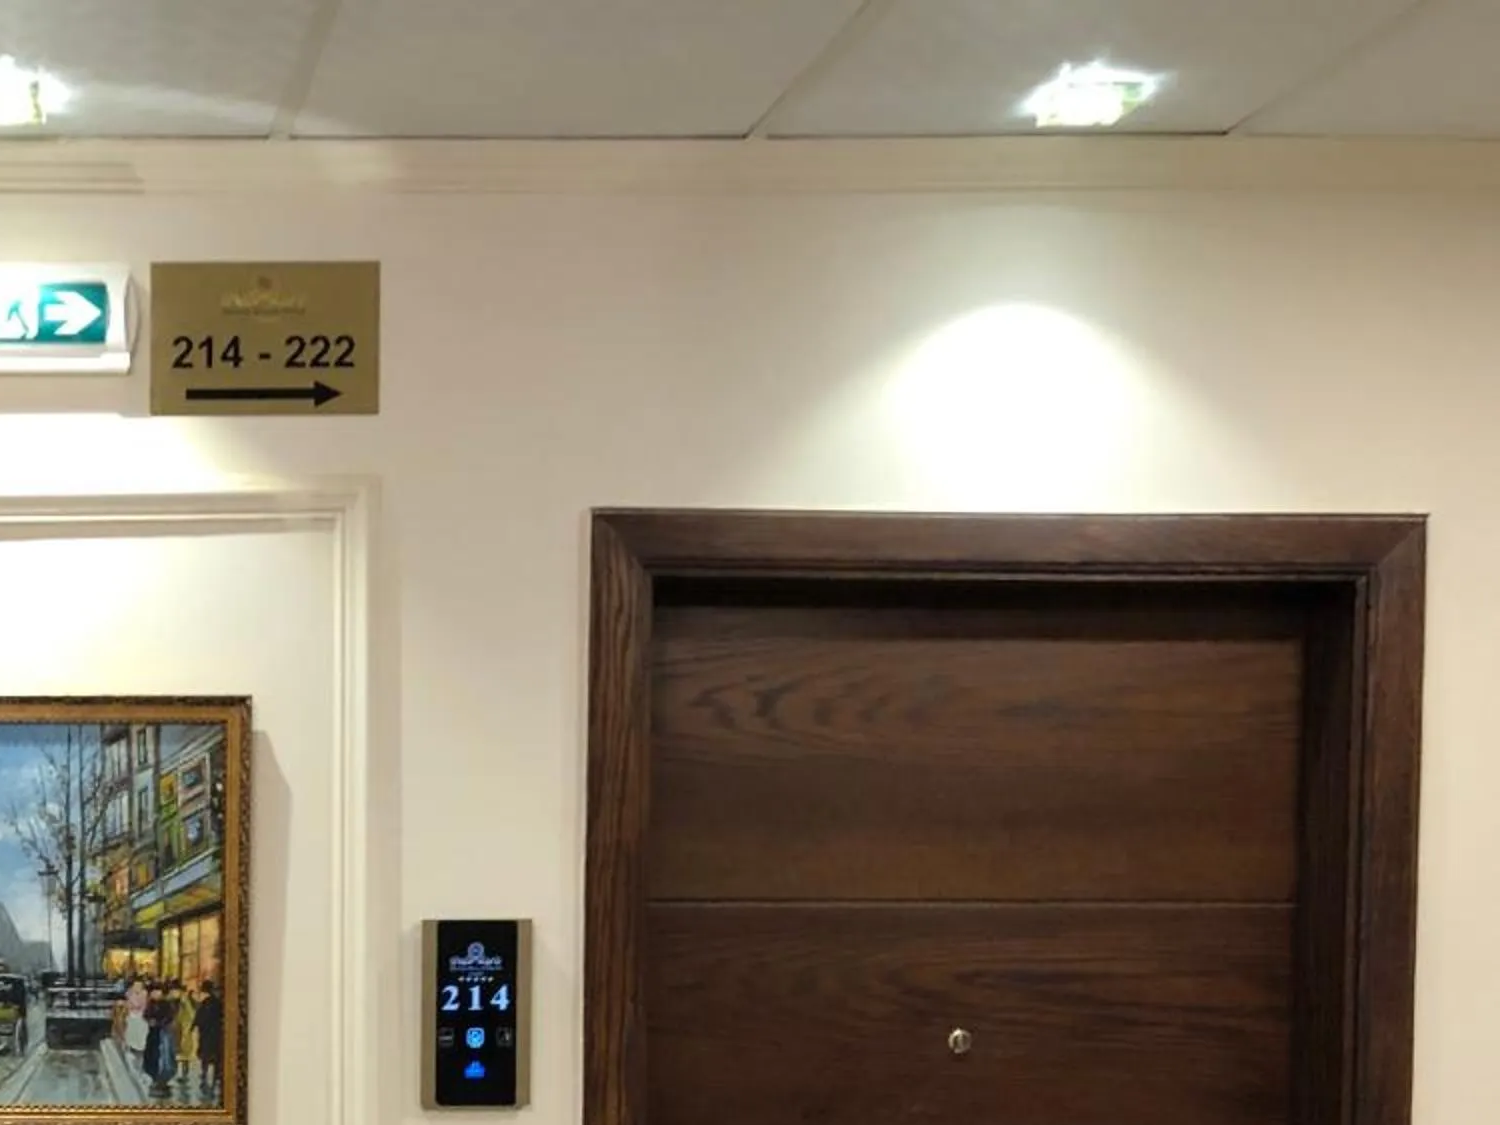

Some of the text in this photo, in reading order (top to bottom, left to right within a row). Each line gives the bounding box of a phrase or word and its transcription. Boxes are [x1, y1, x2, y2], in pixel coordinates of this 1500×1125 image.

[172, 335, 243, 369] 214
[285, 335, 355, 369] 222
[441, 985, 510, 1011] 214
